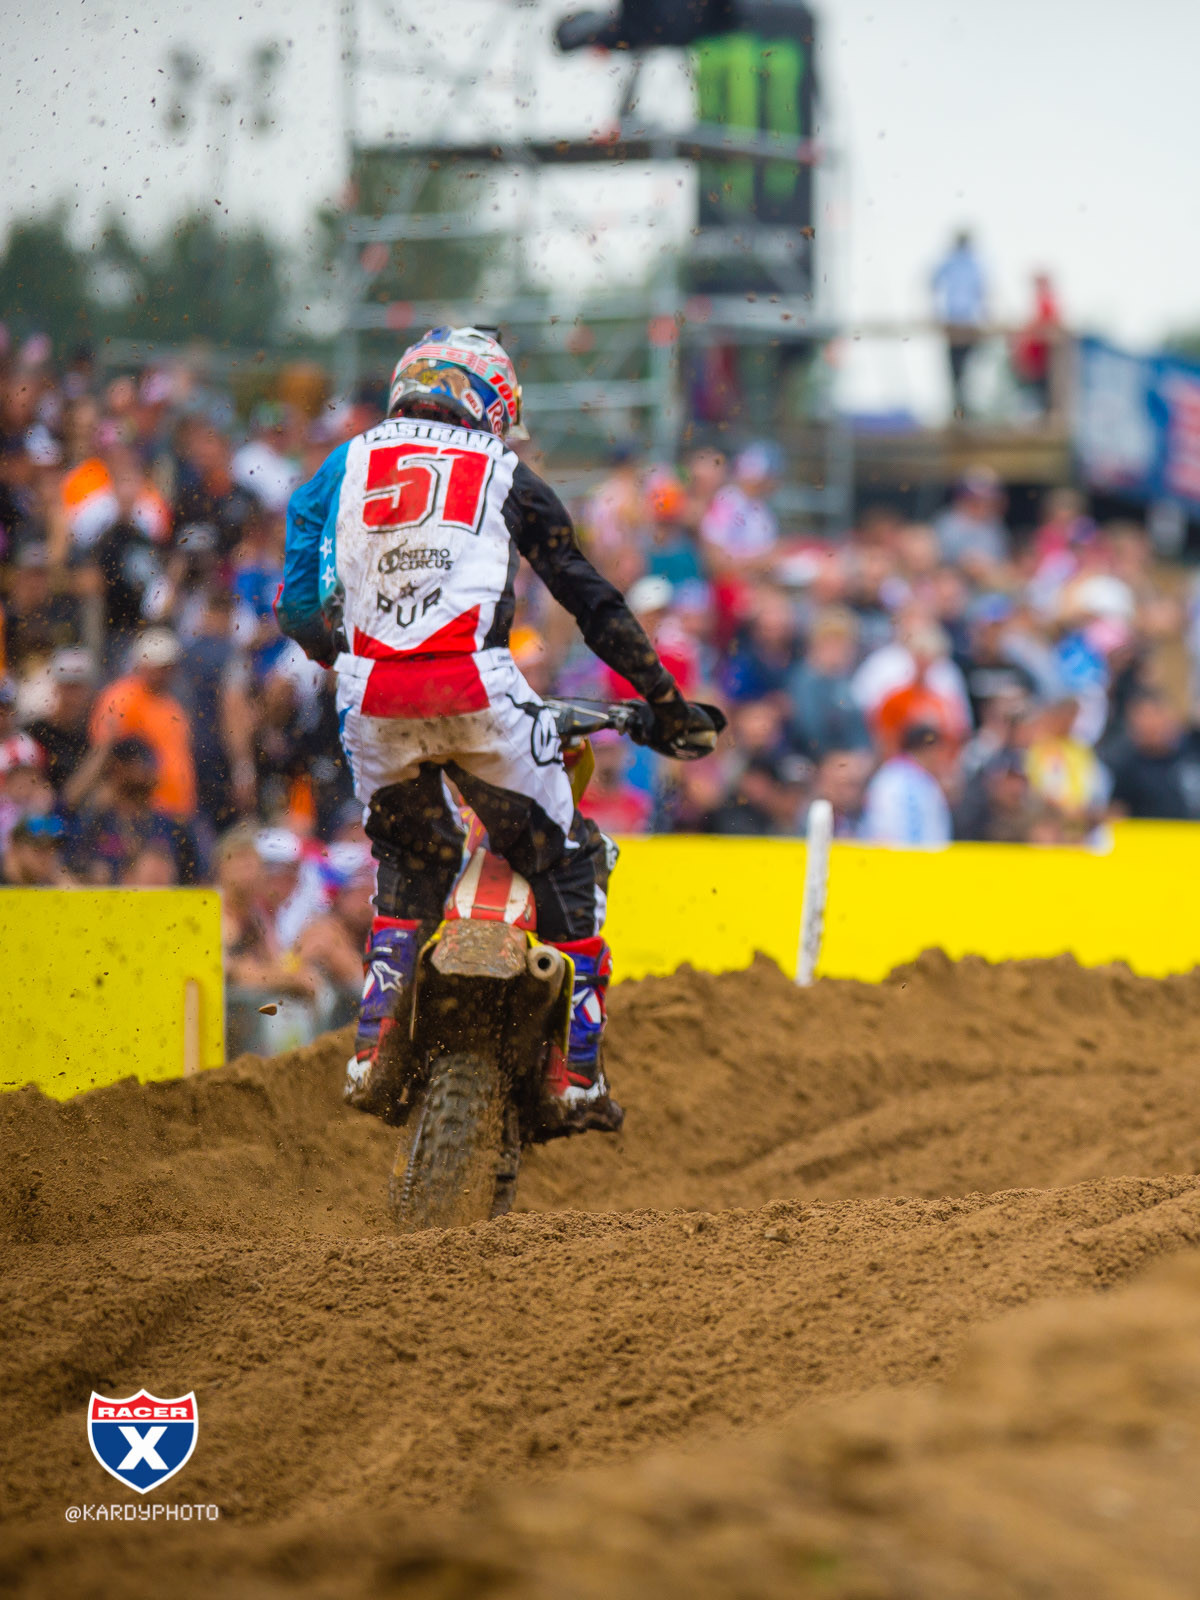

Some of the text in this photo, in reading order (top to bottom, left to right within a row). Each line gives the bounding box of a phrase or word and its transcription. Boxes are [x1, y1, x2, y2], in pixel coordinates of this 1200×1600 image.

[486, 398, 505, 438] Re
[364, 422, 505, 458] PASTRANA
[362, 442, 495, 535] 51
[398, 559, 454, 571] CIRCUS
[401, 548, 450, 560] NITRO
